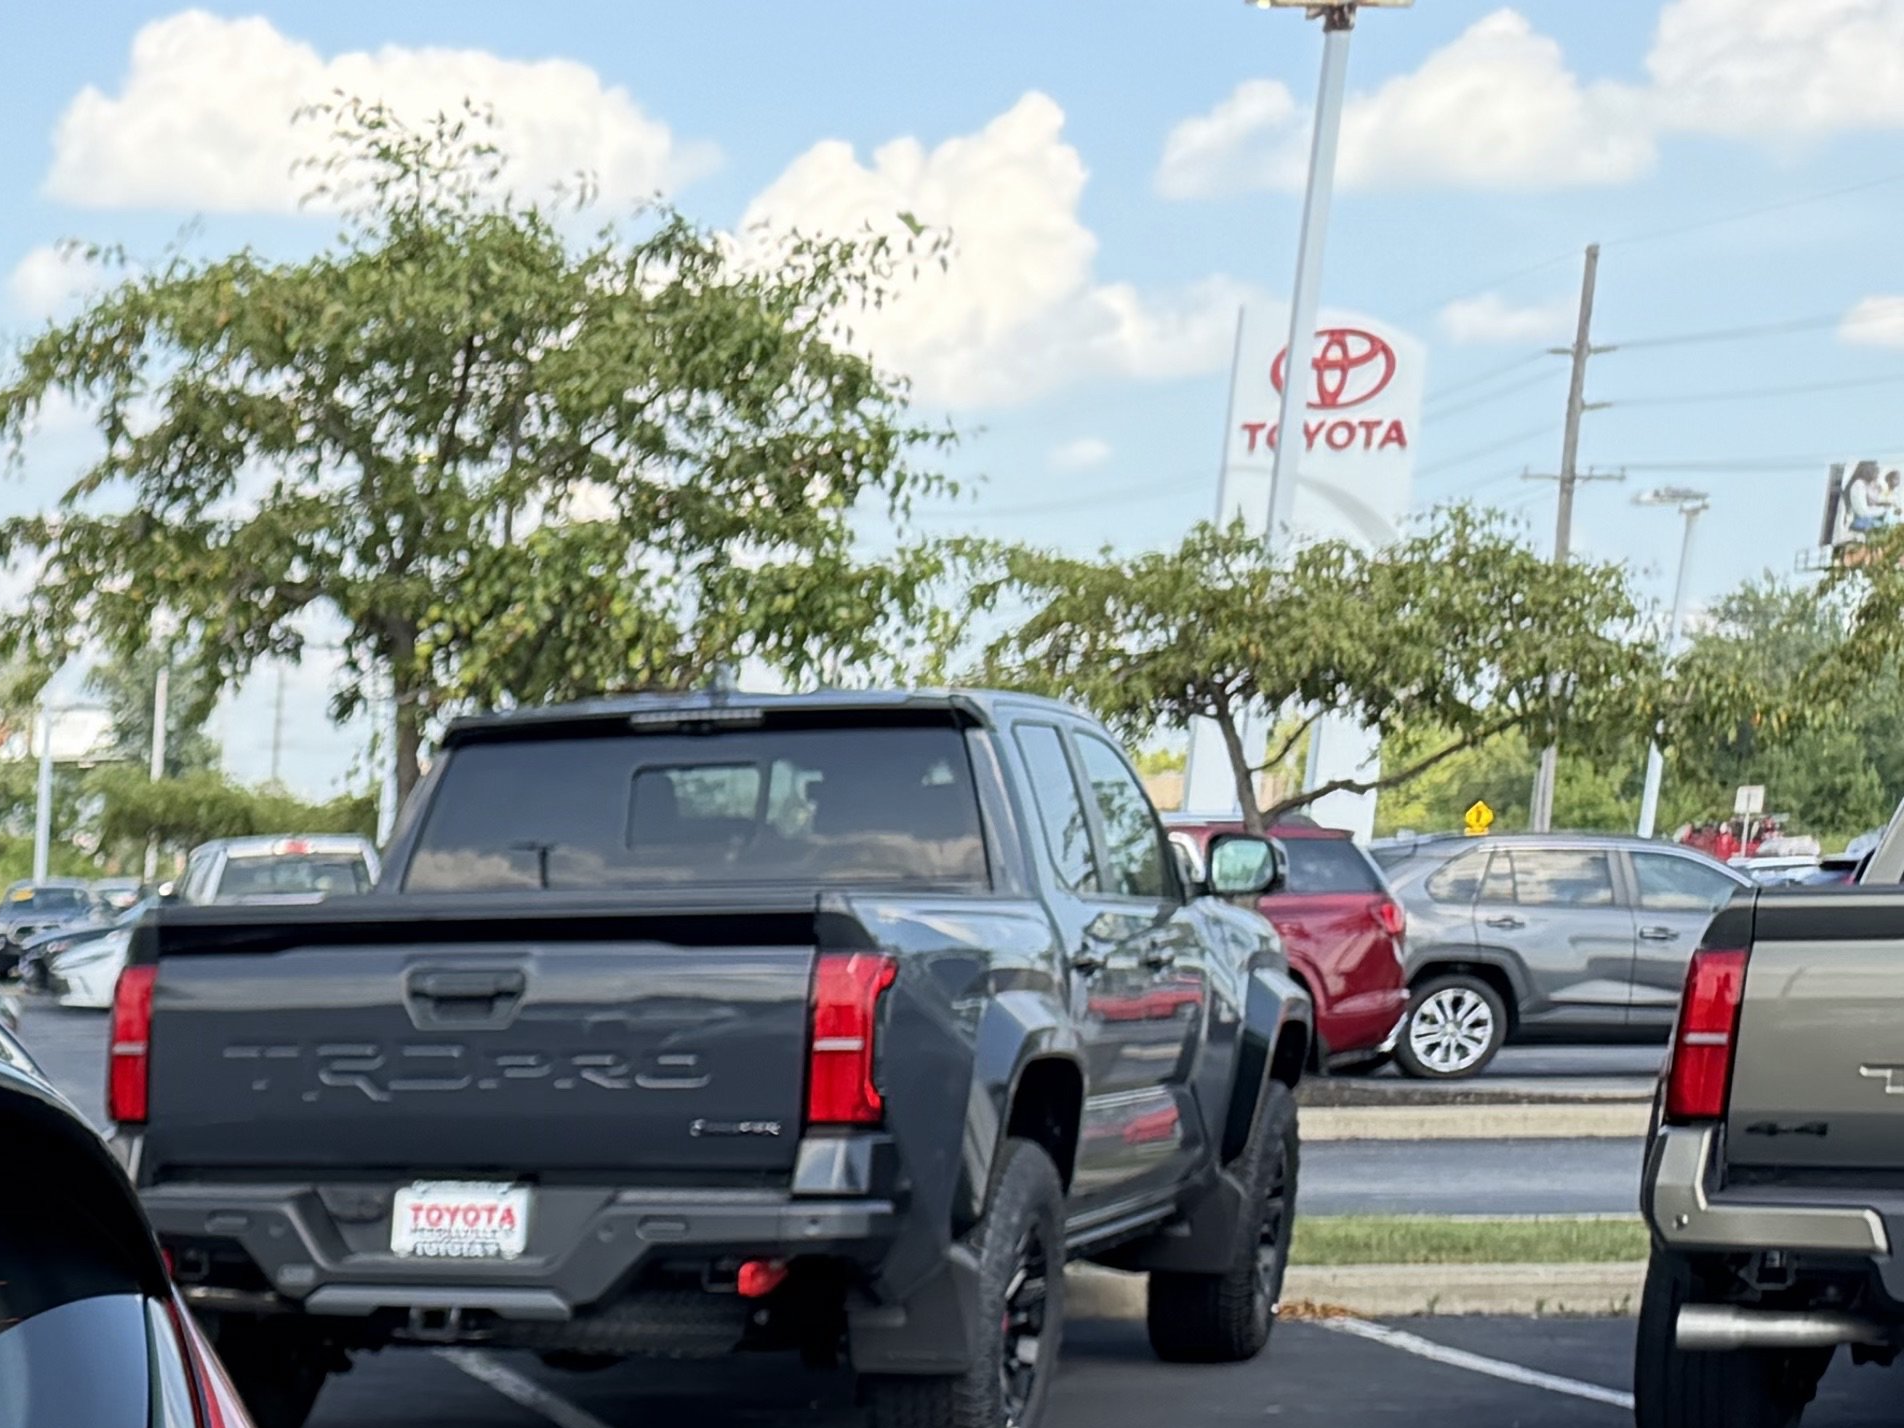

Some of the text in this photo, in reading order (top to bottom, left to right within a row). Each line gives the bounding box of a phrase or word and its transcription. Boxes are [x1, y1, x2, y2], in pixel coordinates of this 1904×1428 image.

[222, 1044, 712, 1101] TRD PRO
[410, 1203, 516, 1229] TOYOTA
